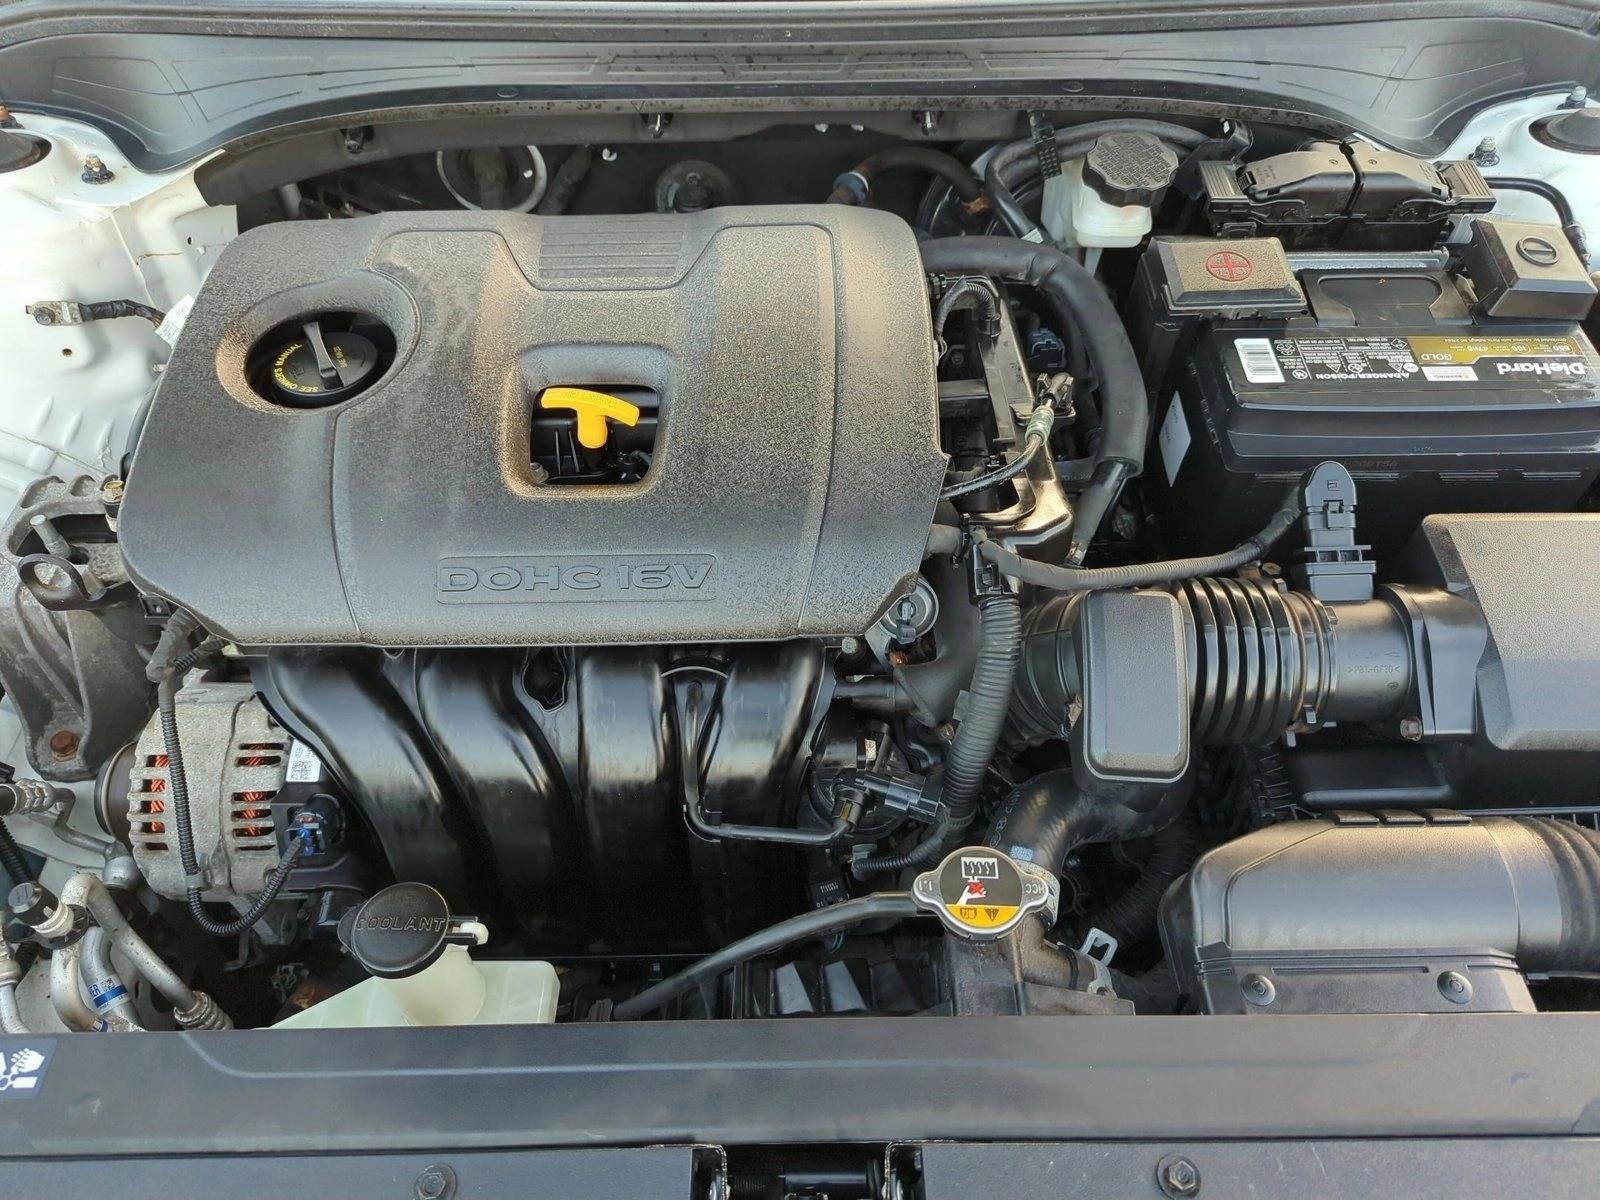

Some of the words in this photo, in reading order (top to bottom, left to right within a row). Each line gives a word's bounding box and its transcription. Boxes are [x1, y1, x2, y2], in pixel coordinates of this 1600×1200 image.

[275, 343, 303, 367] MANUAL
[1496, 362, 1586, 375] DieHard
[300, 385, 319, 393] SEE
[440, 564, 602, 592] DOHC
[616, 563, 713, 590] 16V
[355, 915, 446, 932] COOLANT
